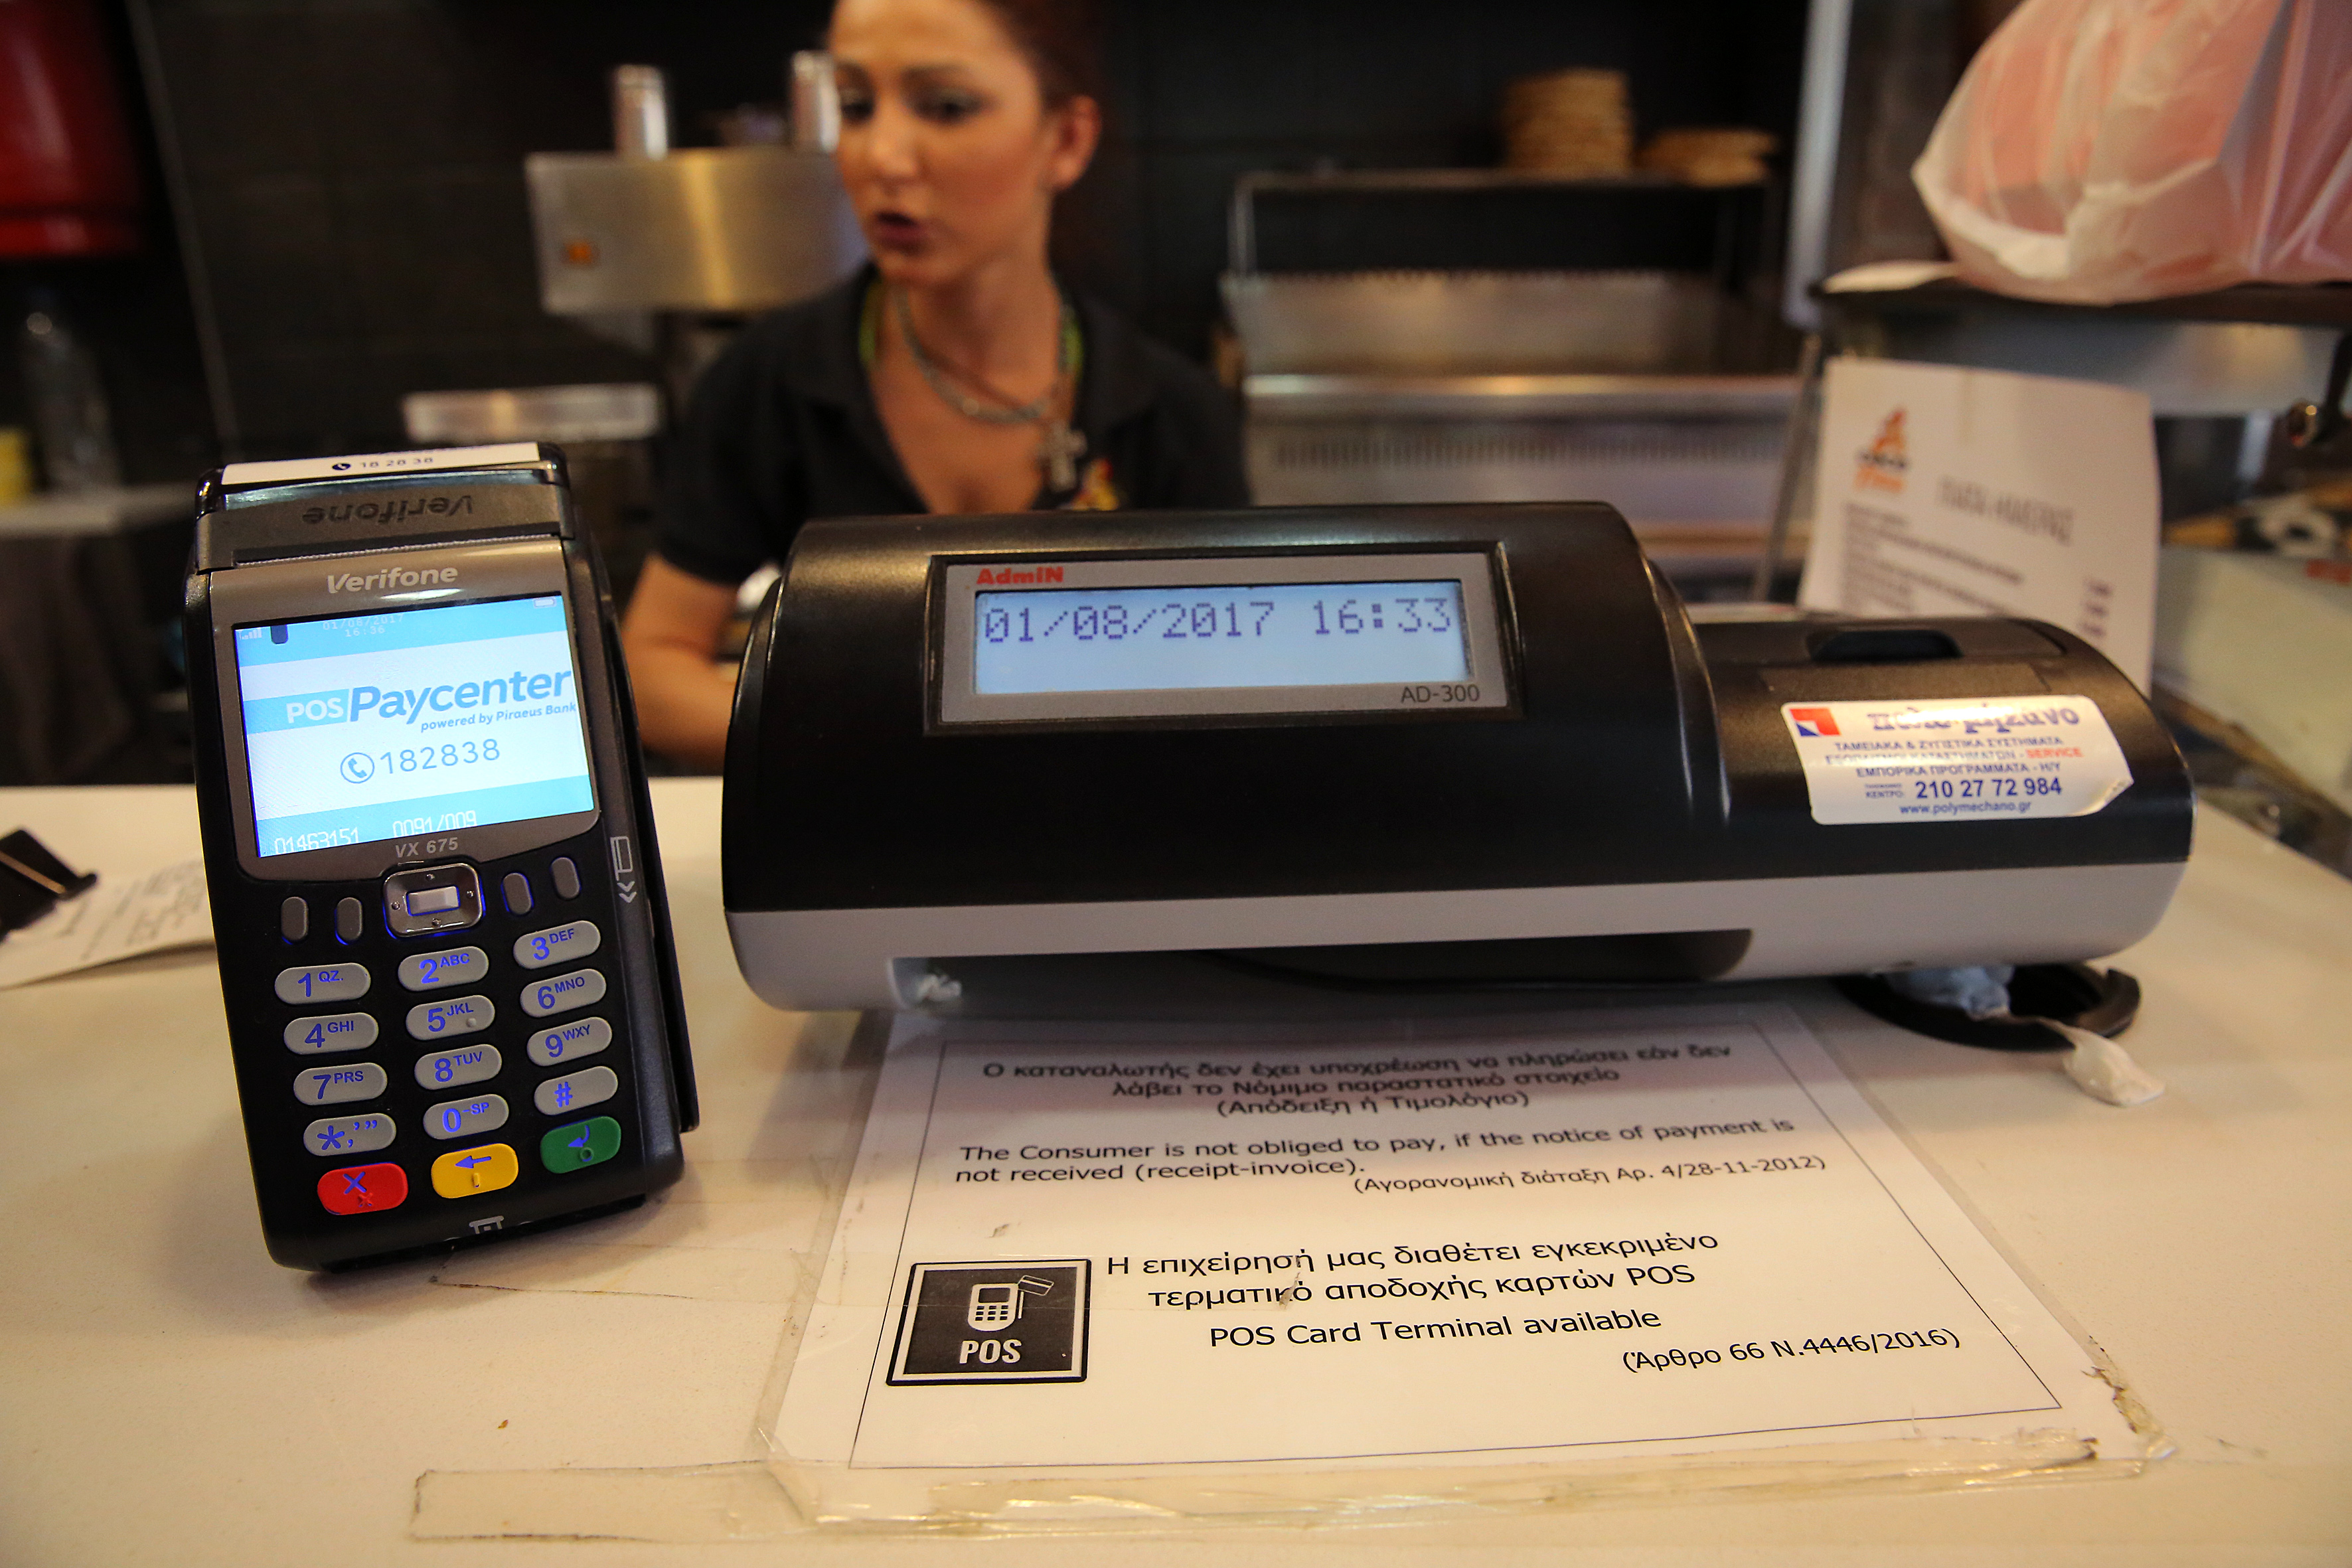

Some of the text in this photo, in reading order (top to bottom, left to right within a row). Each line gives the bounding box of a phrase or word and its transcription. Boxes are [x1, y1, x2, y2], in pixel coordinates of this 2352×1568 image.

[303, 495, 473, 524] Verifone
[327, 566, 459, 594] Verifone
[984, 598, 1450, 643] 01/08/2017 16:33
[285, 668, 572, 725] POS Paycenter
[1401, 684, 1480, 704] AD-300
[421, 702, 576, 733] powered by Piraeus Bank
[380, 738, 501, 775] 182838
[2025, 747, 2084, 758] SERVICE
[1915, 777, 2062, 799] 210 27 72 984
[1899, 801, 2031, 815] www.polymechano.gr
[395, 838, 458, 858] VX 675
[530, 929, 575, 961] 3 DEF
[419, 953, 470, 984] 2 ABC
[298, 973, 312, 996] 1
[537, 977, 586, 1009] 6 MNO
[427, 1004, 473, 1032] 5 JKL
[304, 1021, 354, 1048] 4 GHI
[545, 1025, 590, 1058] 9 WXY
[434, 1052, 482, 1082] 8 TUV
[983, 1043, 1731, 1079] Ο καταναλωτής δεν έχει υποχρέωση να πληρώσει εάν δεν
[313, 1071, 364, 1099] 7 PRS
[1113, 1067, 1620, 1097] λάβει το Νόμιμο παραστατικό στοιχείο
[1217, 1091, 1530, 1117] (Απόδειξη ή Τιμολόγιο)
[441, 1108, 461, 1133] 0
[960, 1118, 1795, 1161] The Consumer is not obliged to pay, if the notice of payment is
[956, 1158, 1365, 1182] not received (receipt-invoice).
[1354, 1155, 1826, 1194] (Αγορανομική διάταξη Αρ. 4/28-11-2012)
[1107, 1233, 1719, 1278] Η επιχείρησή μας διαθέτει εγκεκριμένο
[1148, 1264, 1695, 1310] τερματικό αποδοχής καρτών POS
[1210, 1309, 1661, 1347] POS Card Terminal available
[959, 1338, 1022, 1365] POS
[1623, 1328, 1961, 1373] (Άρθρο 66 Ν.4446/2016)
